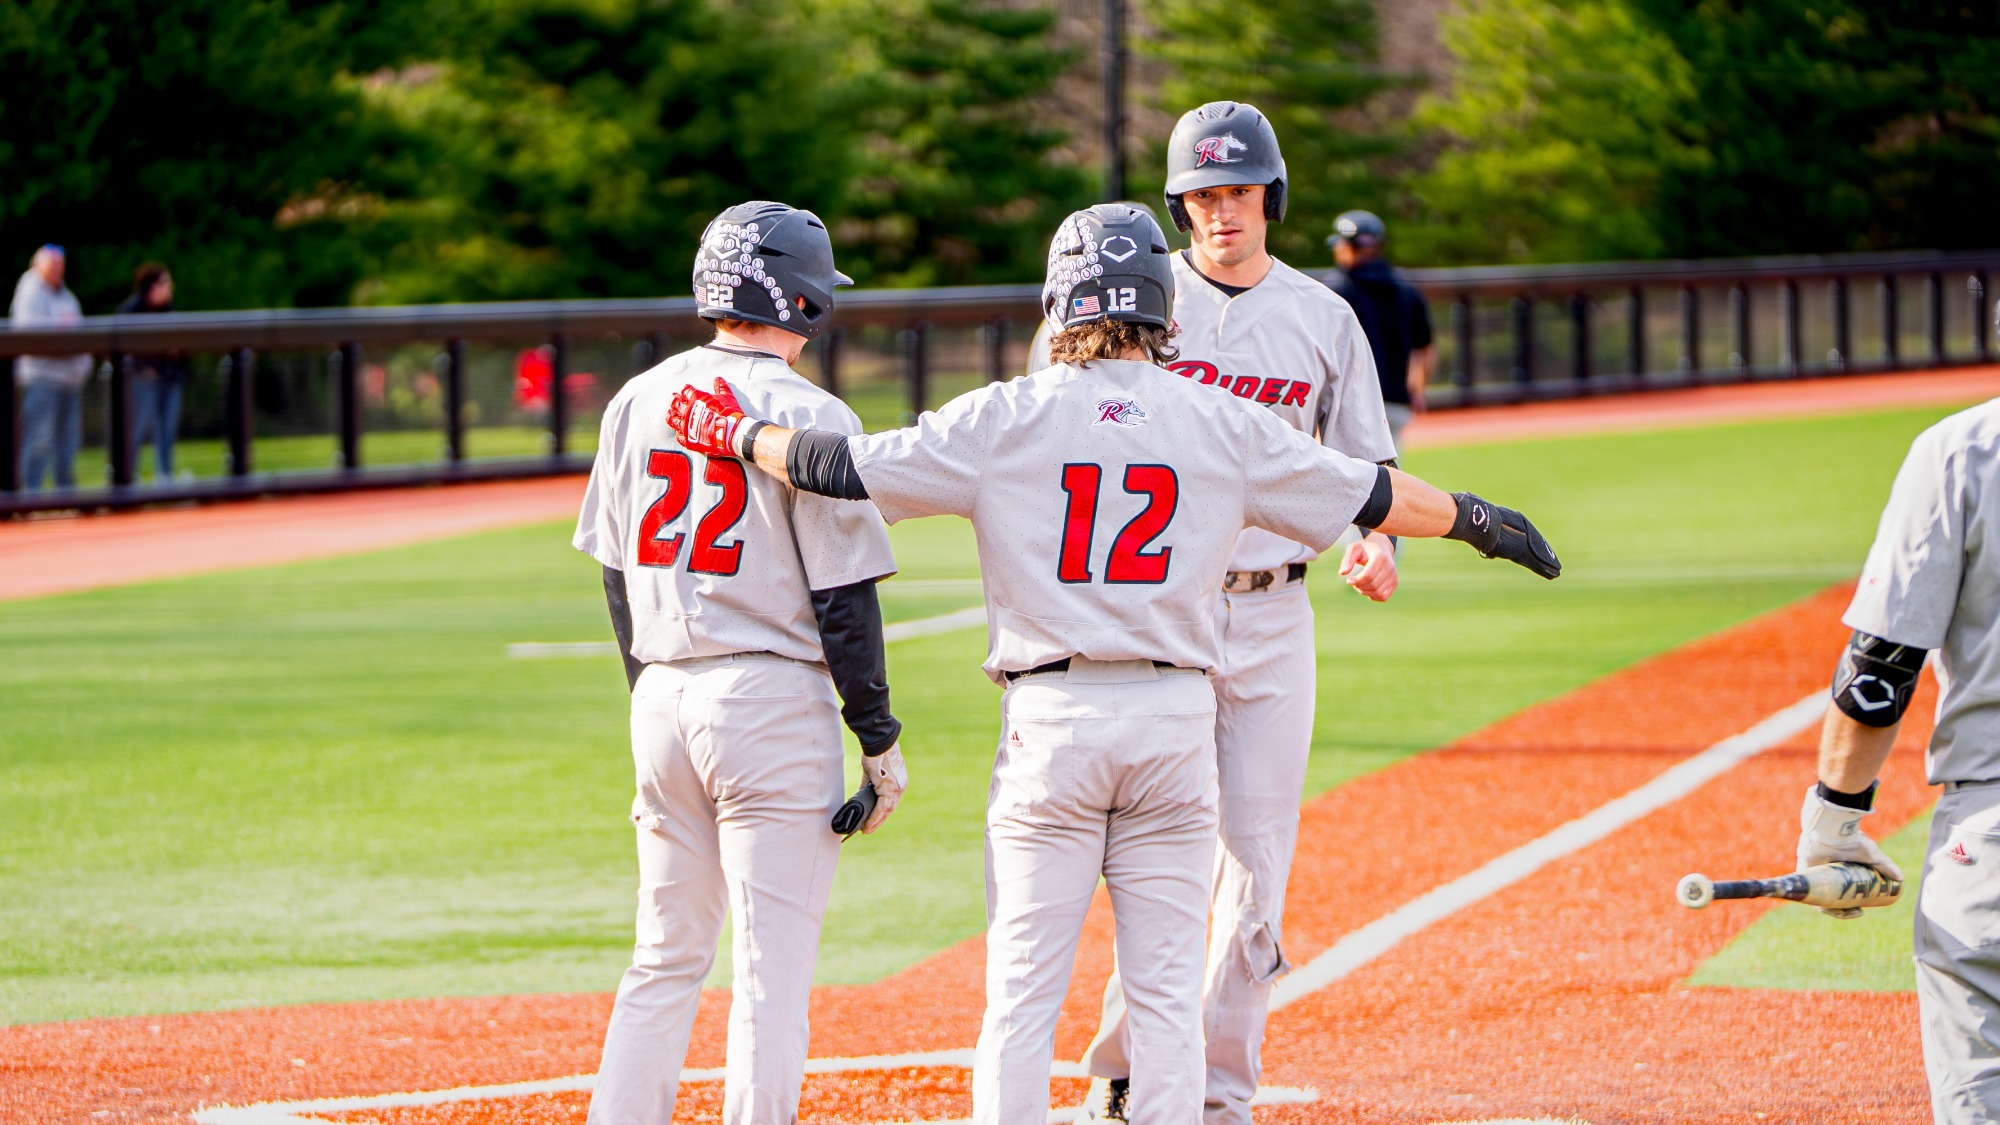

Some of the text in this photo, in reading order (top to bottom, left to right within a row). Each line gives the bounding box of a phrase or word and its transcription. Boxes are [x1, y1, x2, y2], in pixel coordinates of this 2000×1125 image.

[707, 284, 734, 309] 22
[1106, 287, 1137, 311] 12
[637, 449, 748, 576] 22
[1057, 463, 1179, 584] 12
